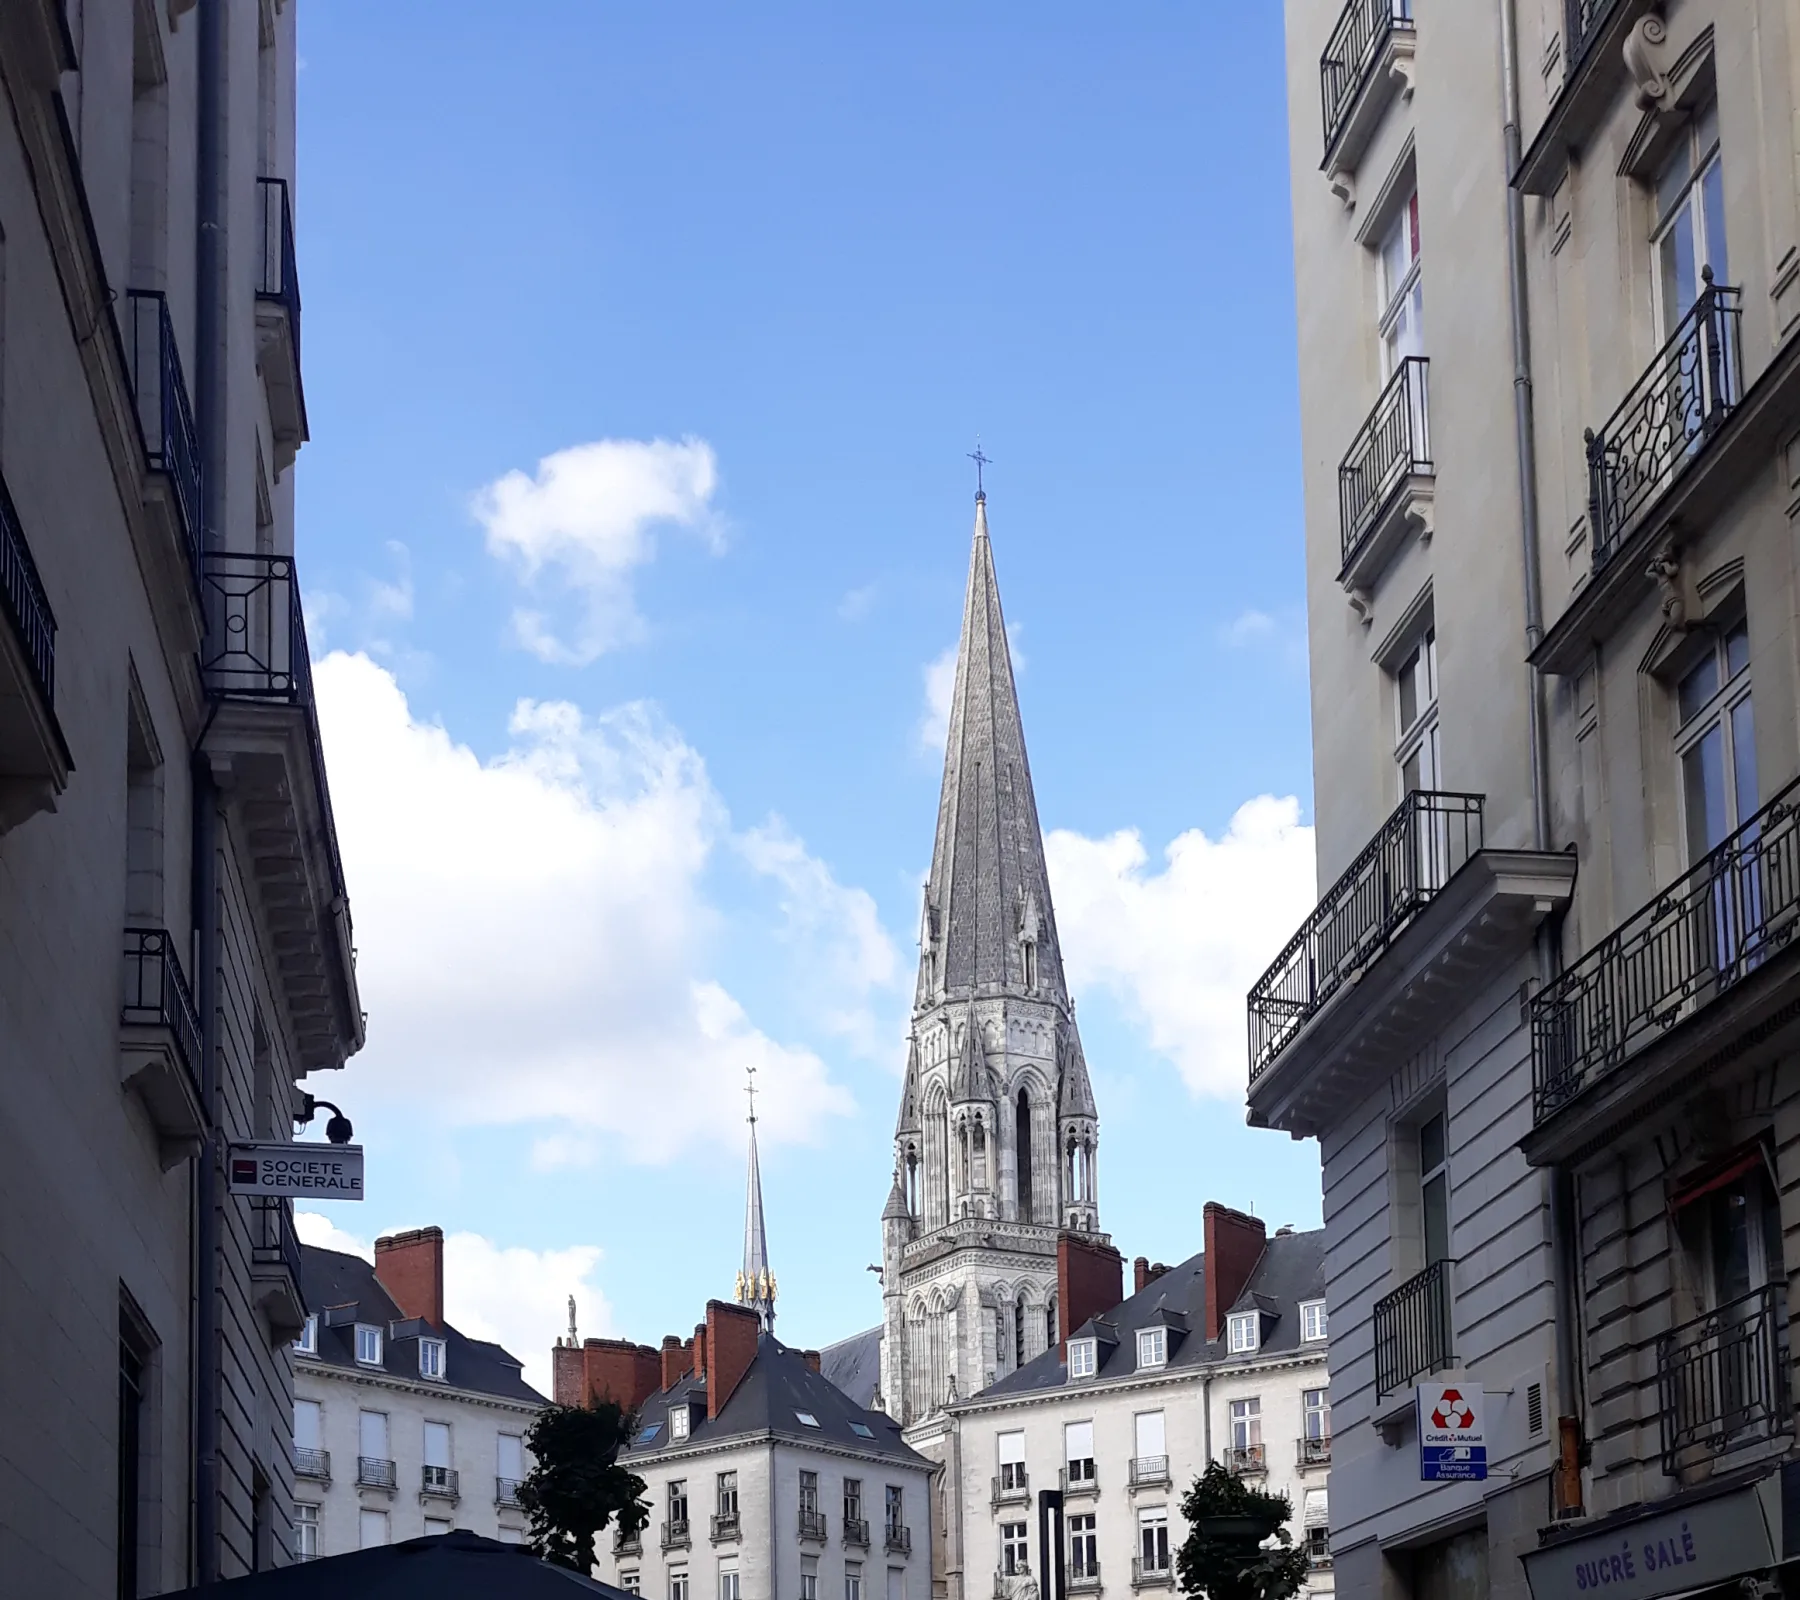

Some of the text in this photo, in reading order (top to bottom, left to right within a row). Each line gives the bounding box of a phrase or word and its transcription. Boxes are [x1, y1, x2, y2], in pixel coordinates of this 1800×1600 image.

[262, 1160, 343, 1175] SOCIETE
[262, 1174, 362, 1189] GENERALE
[1435, 1471, 1477, 1479] Assurance
[1440, 1464, 1470, 1472] Banque
[1575, 1521, 1697, 1590] SUCRÉ SALÉ
